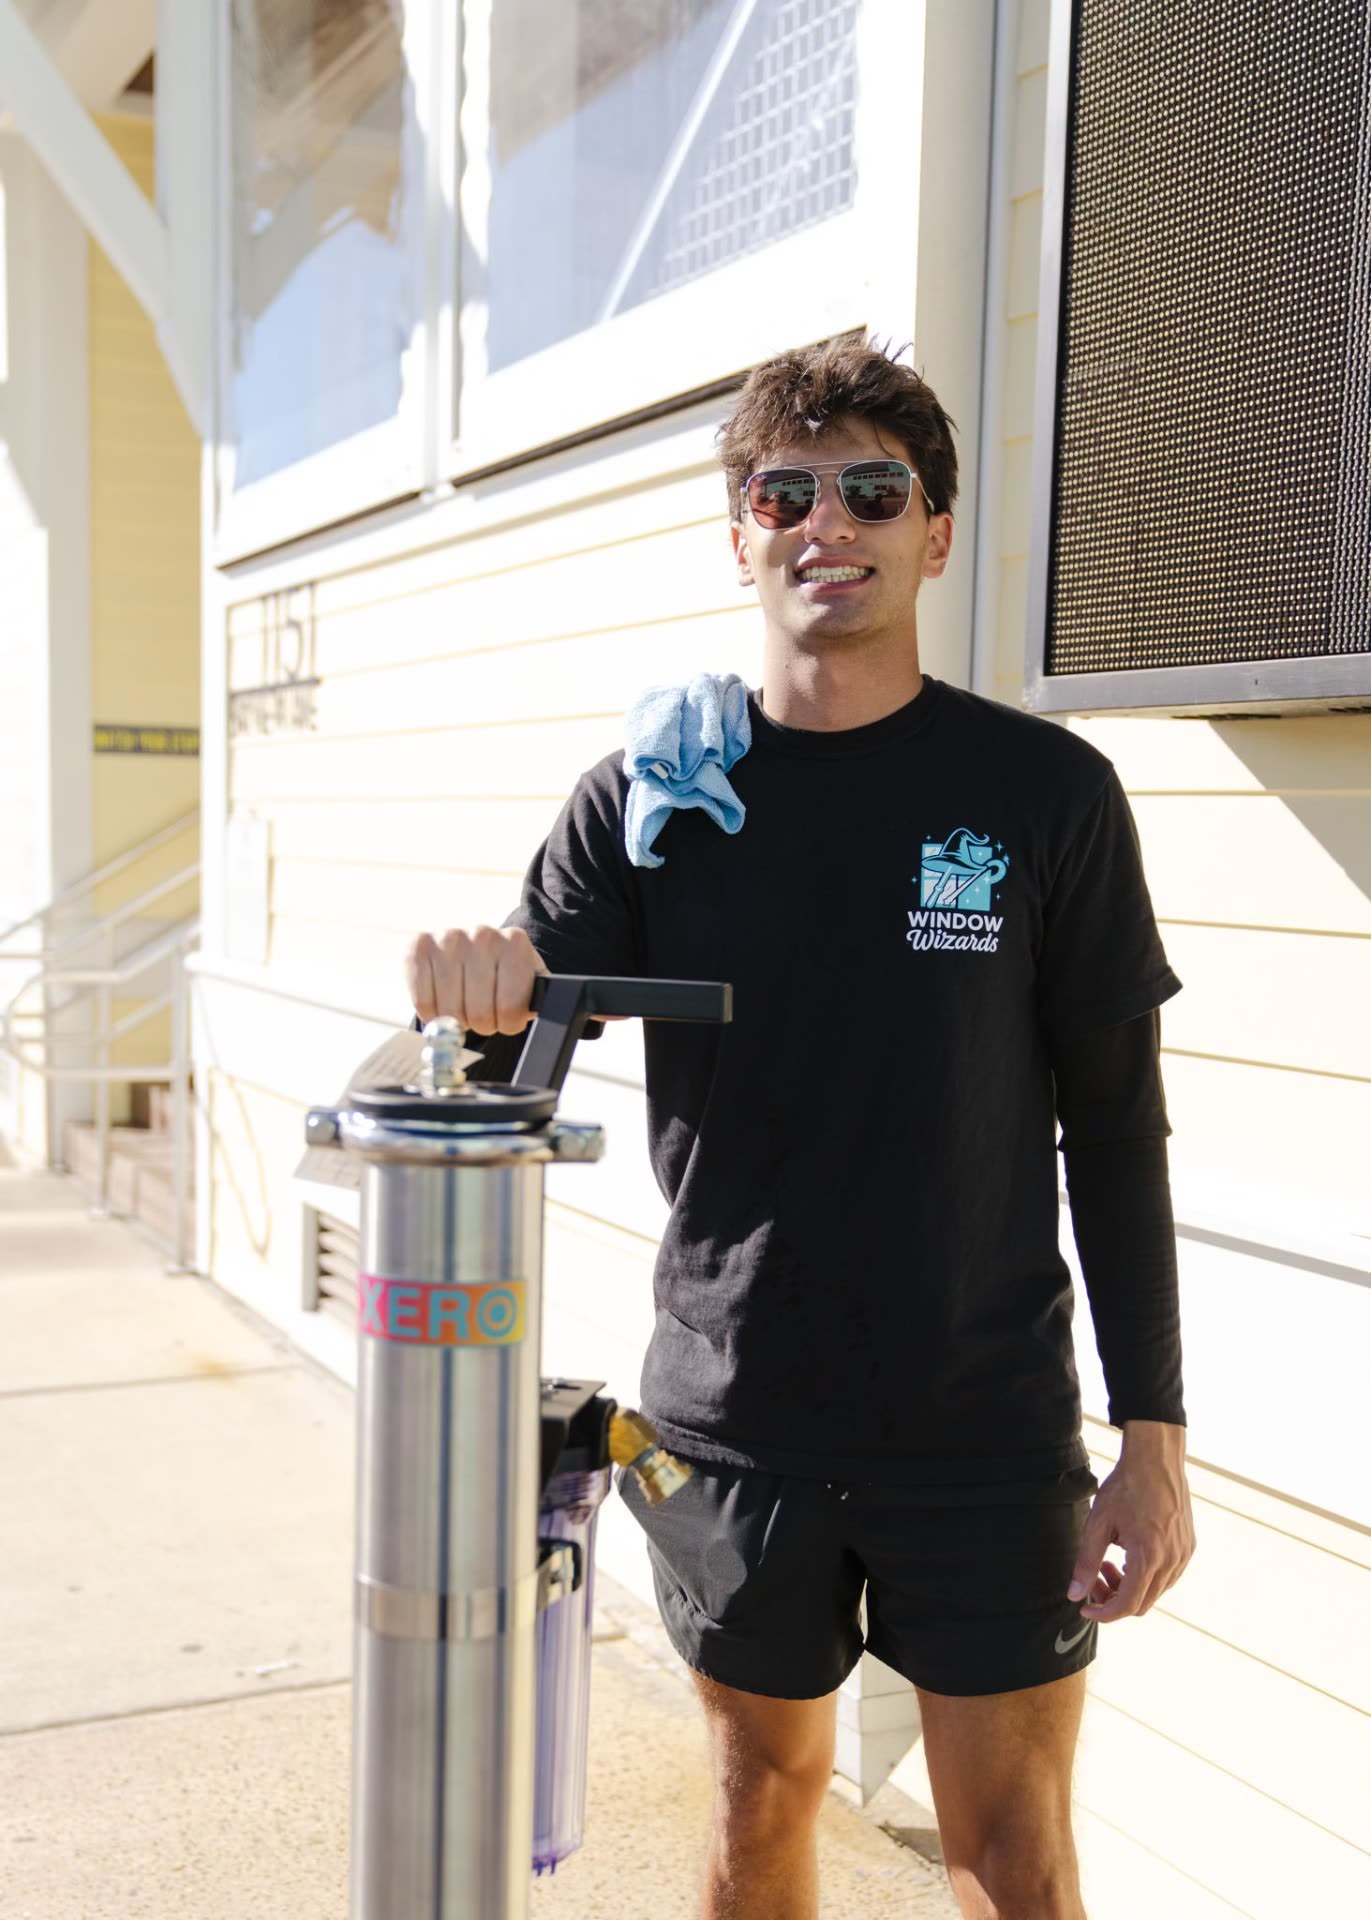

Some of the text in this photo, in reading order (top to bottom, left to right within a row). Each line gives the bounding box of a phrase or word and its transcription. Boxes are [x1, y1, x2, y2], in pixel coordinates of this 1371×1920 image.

[907, 911, 1004, 933] WINDOW
[906, 929, 999, 953] Wizards
[361, 1281, 518, 1339] XERO
